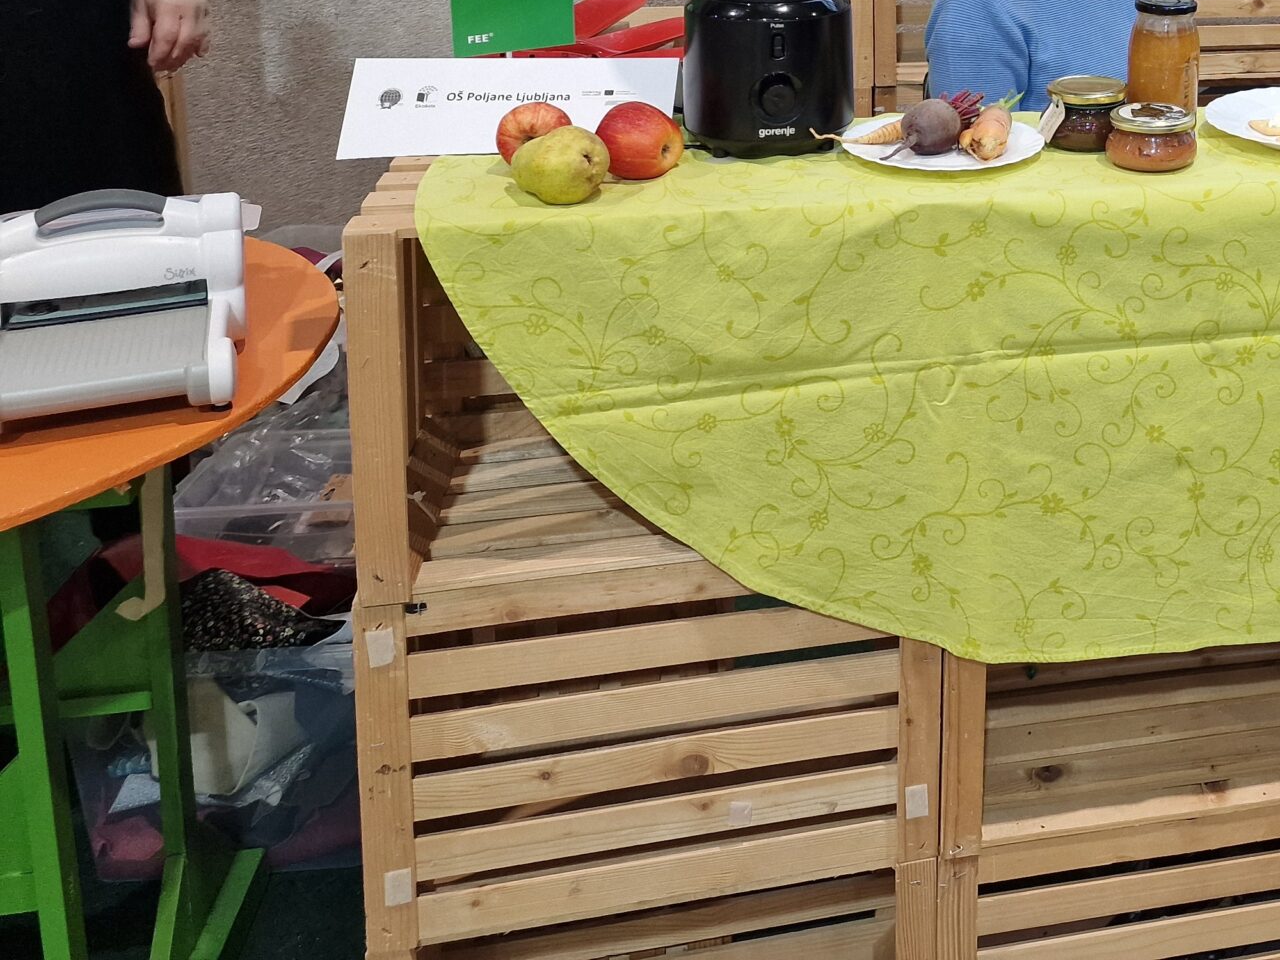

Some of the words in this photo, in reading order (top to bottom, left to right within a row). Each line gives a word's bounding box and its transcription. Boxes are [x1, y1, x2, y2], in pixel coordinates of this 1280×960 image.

[446, 90, 463, 101] OŠ
[467, 92, 512, 103] Poljane
[516, 92, 571, 103] Ljubljana
[758, 126, 796, 138] gorenje
